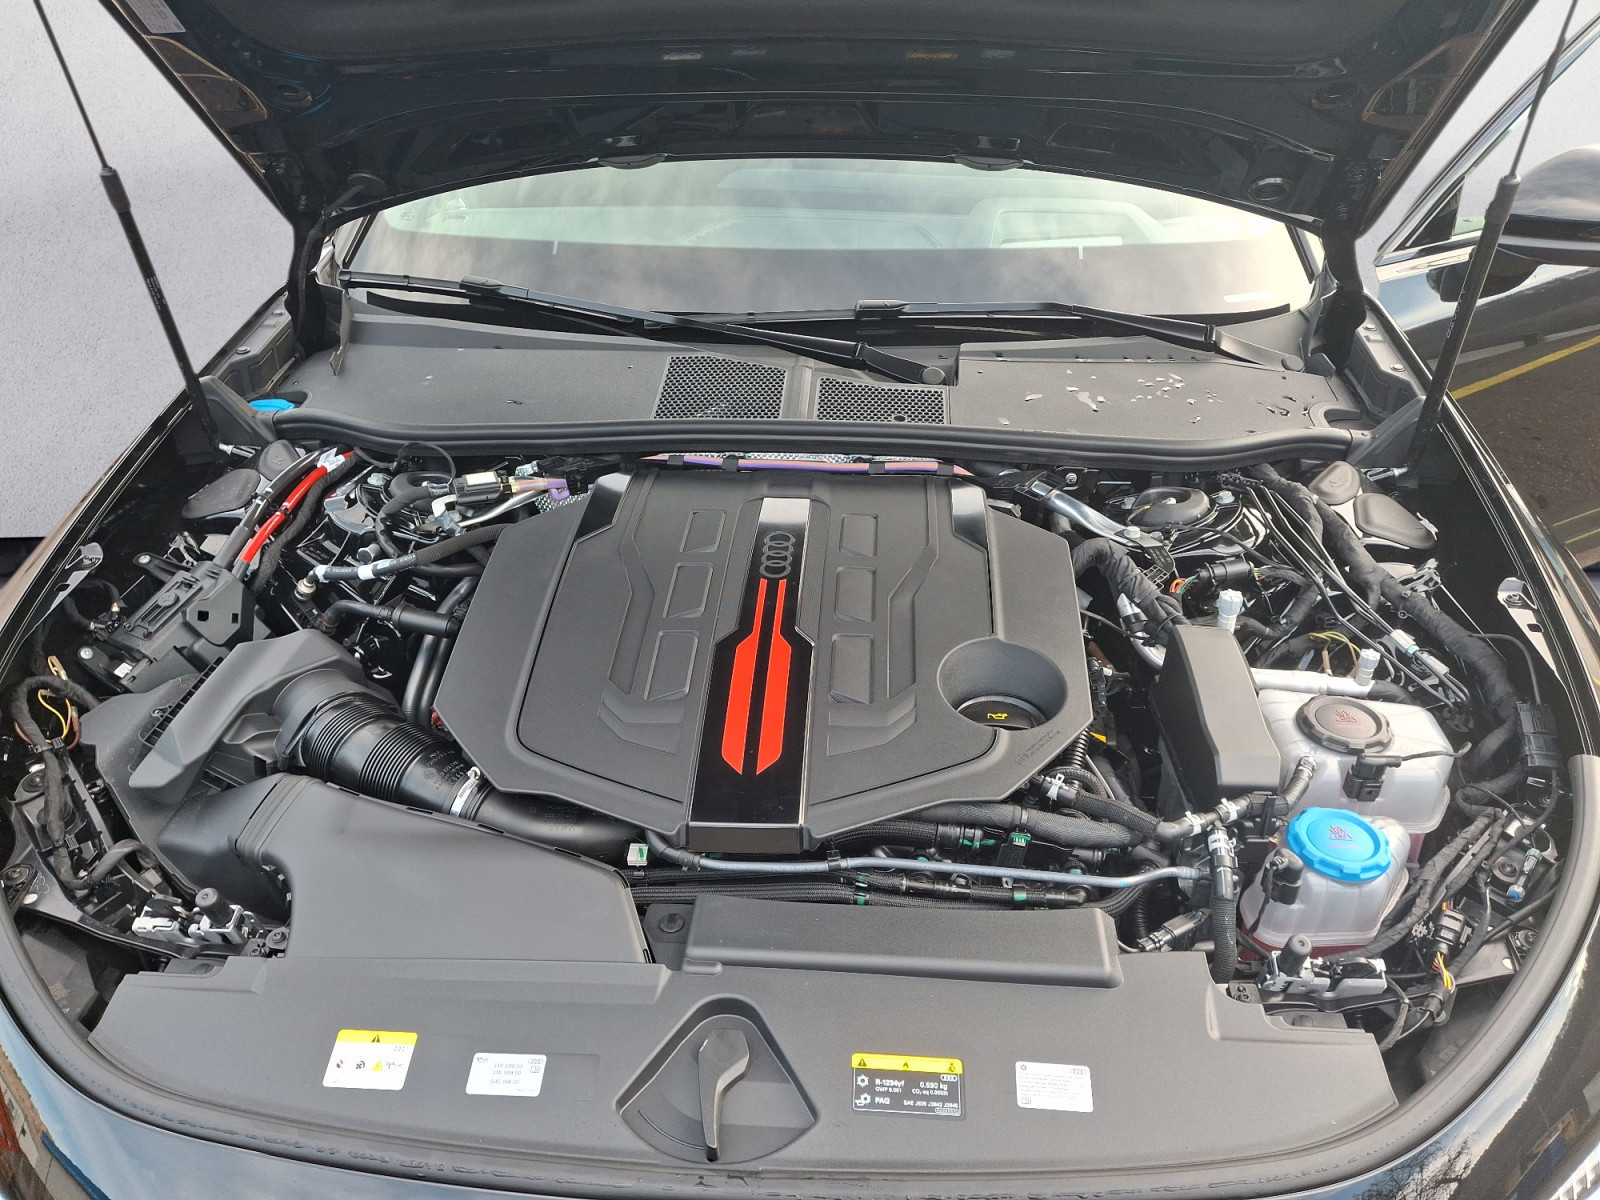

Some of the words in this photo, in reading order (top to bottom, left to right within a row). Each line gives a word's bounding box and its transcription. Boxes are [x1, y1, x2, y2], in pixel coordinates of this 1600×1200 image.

[874, 1078, 905, 1088] R-1234yf
[939, 1082, 948, 1091] kg
[874, 1096, 890, 1105] PAG
